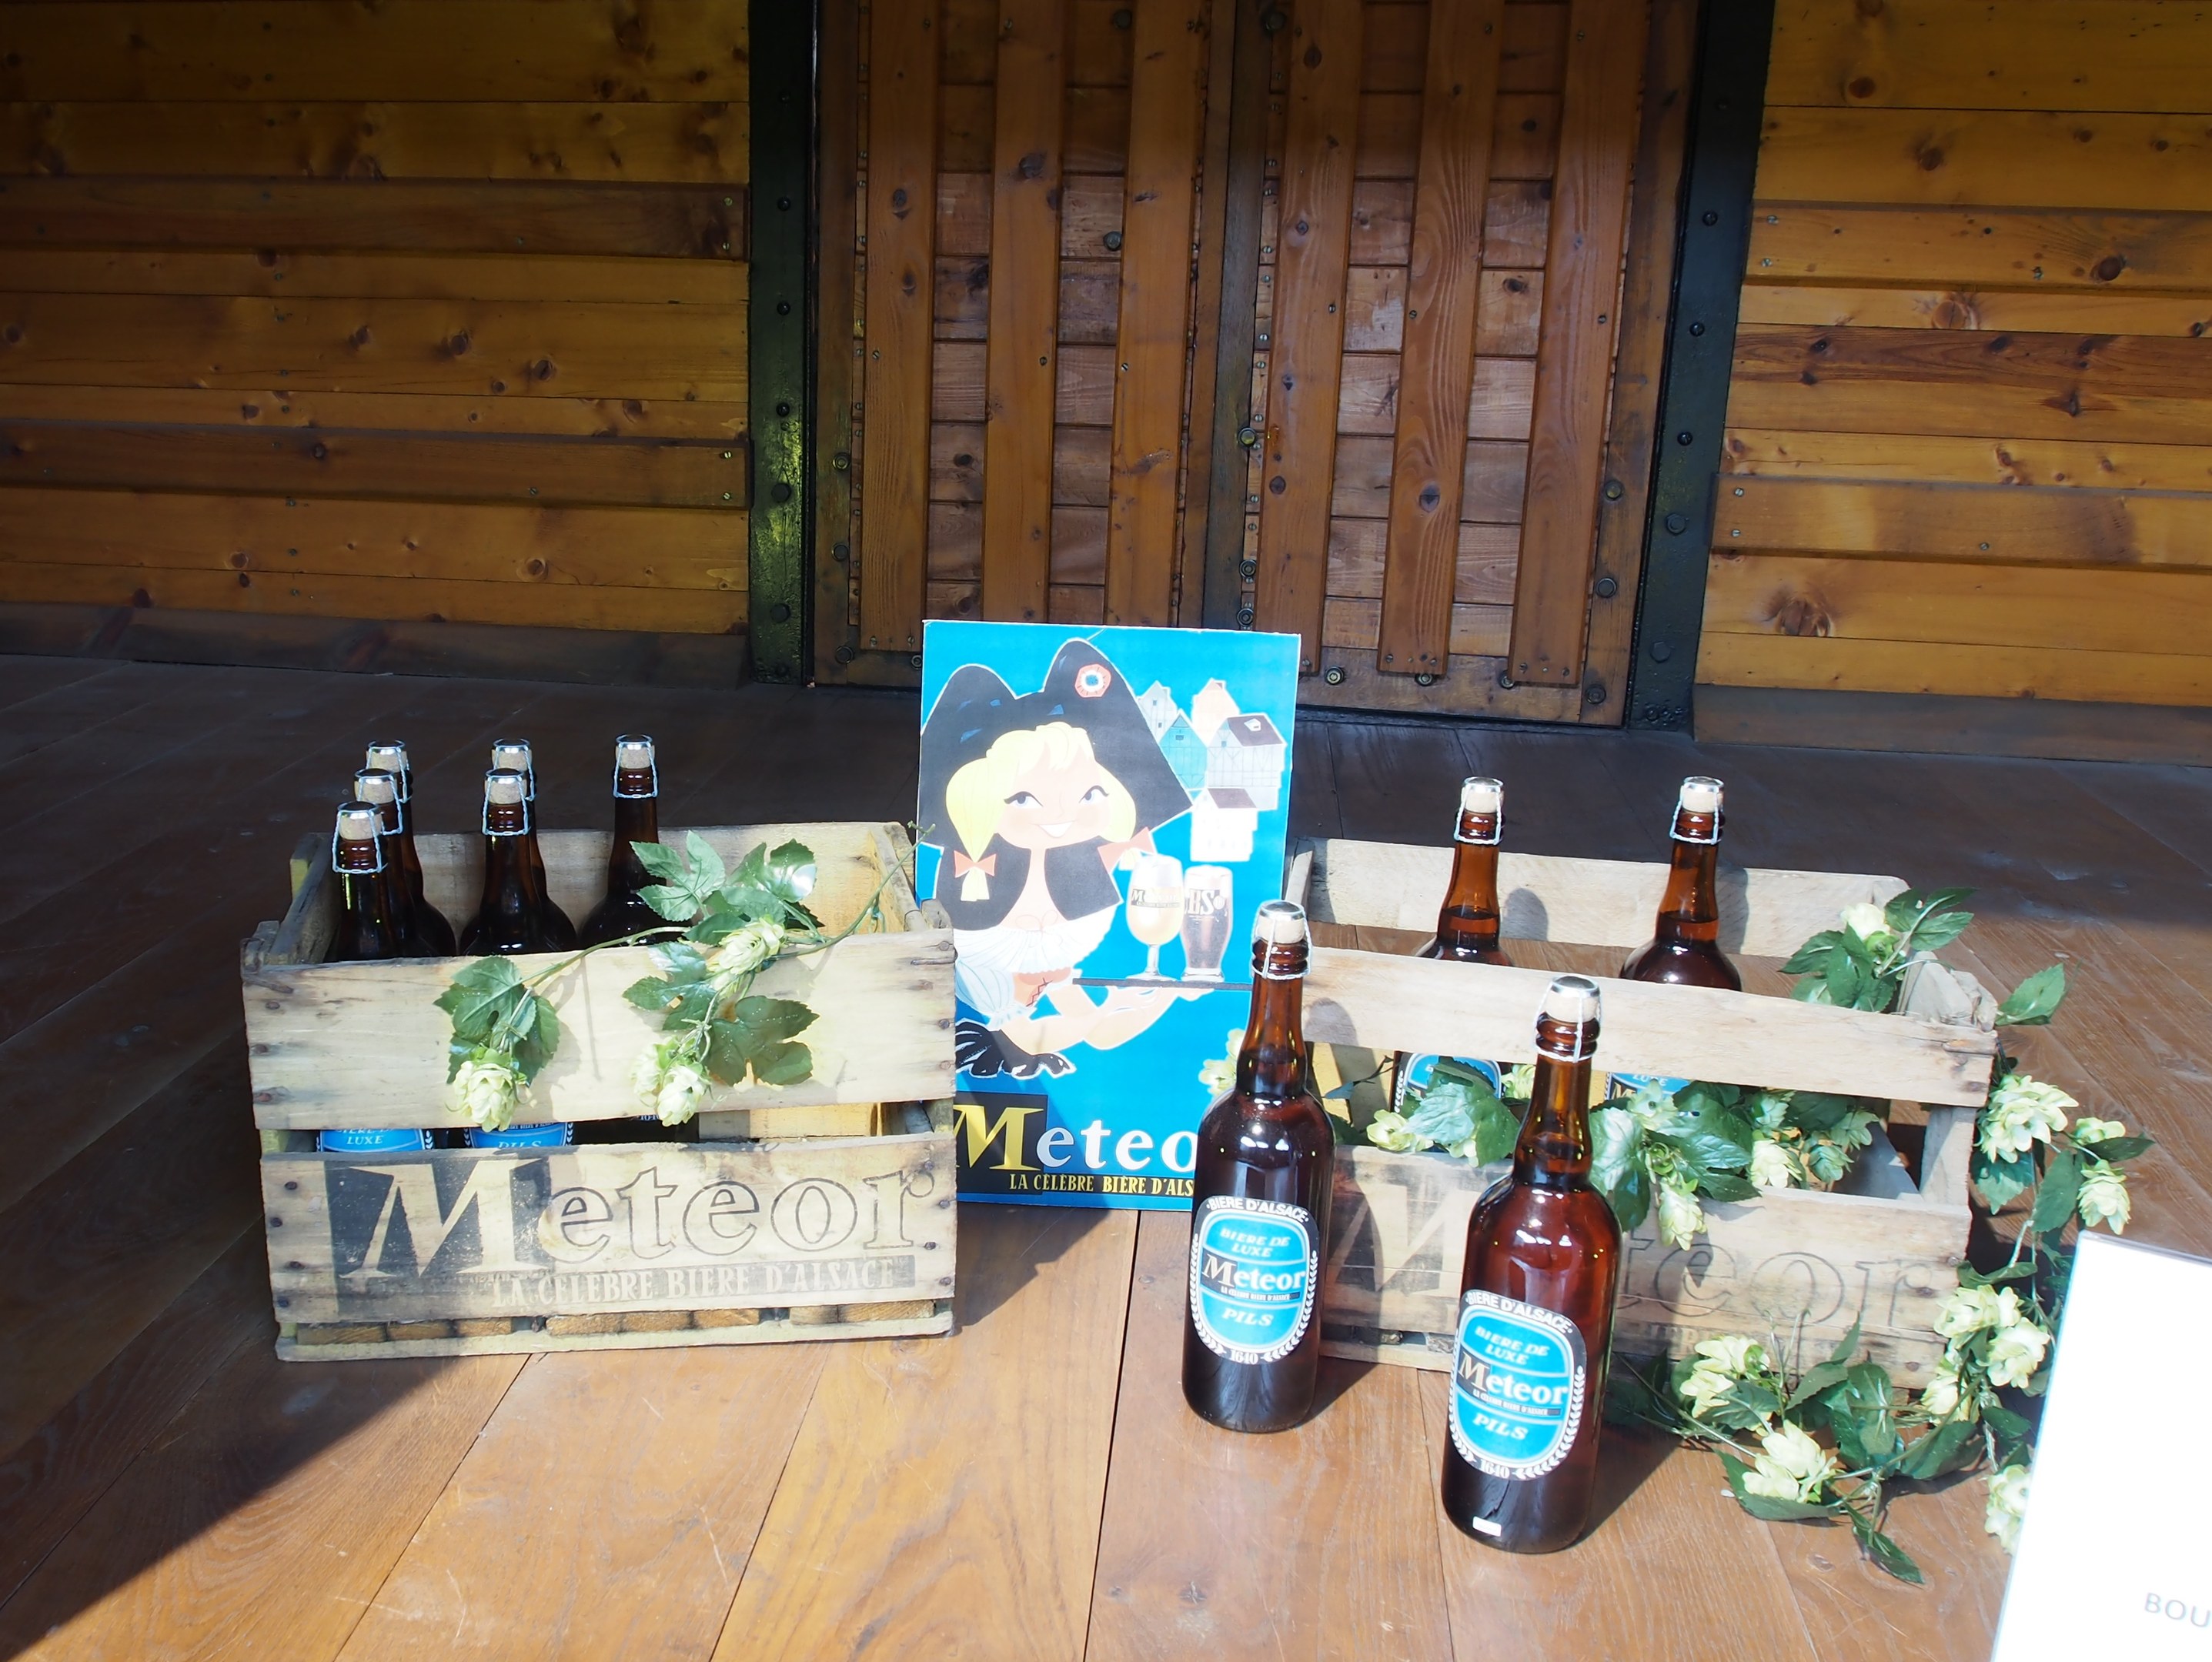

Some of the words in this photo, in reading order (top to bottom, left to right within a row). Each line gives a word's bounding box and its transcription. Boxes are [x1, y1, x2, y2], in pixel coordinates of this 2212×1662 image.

[347, 1135, 383, 1145] LUXE
[1009, 1173, 1028, 1190] LA
[339, 1159, 936, 1280] Meteor
[1246, 1200, 1308, 1223] D'ALSACE
[1232, 1243, 1273, 1257] LUXE
[1268, 1236, 1291, 1246] DE
[493, 1277, 526, 1308] LA
[764, 1258, 894, 1295] D'ALSACE
[1201, 1253, 1306, 1291] Meteor
[1221, 1307, 1274, 1327] PILS
[1500, 1298, 1572, 1333] D'ALSACE
[1229, 1349, 1259, 1365] 1640
[1485, 1343, 1529, 1366] LUXE
[1525, 1343, 1550, 1357] DE
[1458, 1352, 1569, 1406] Meteor
[1472, 1413, 1529, 1440] PILS
[1479, 1460, 1510, 1480] 1640
[2145, 1592, 2211, 1628] BOU
